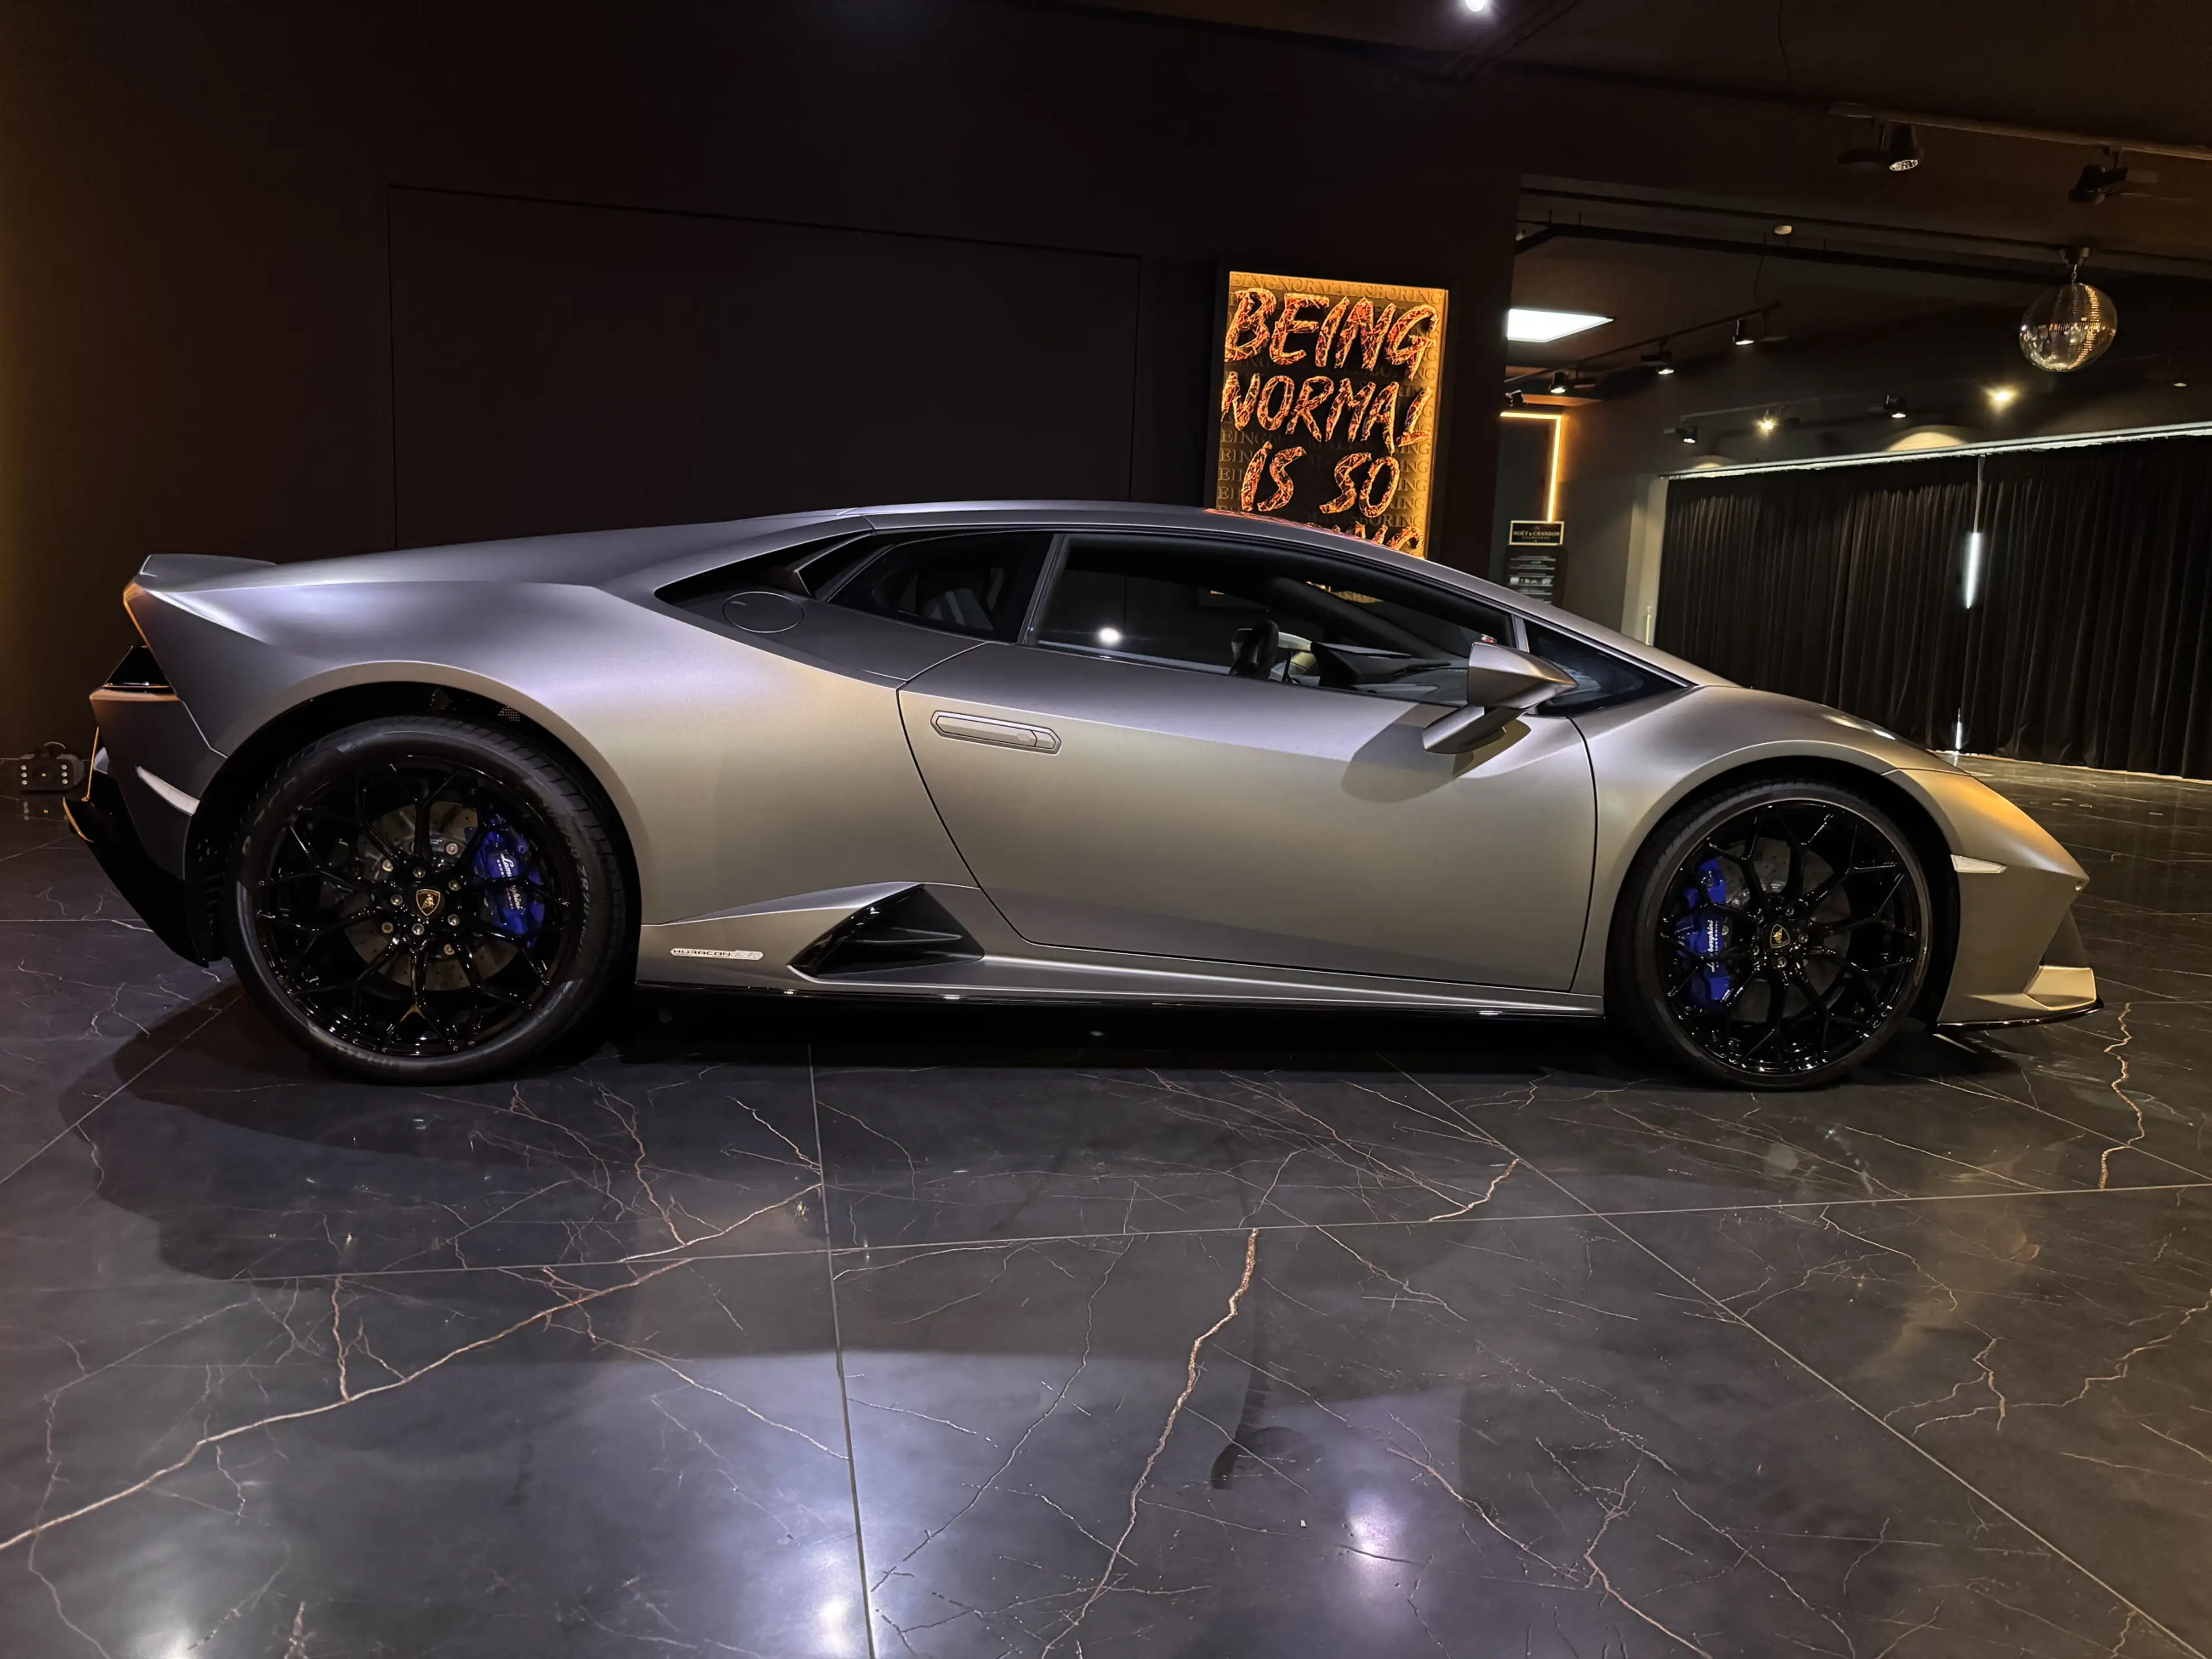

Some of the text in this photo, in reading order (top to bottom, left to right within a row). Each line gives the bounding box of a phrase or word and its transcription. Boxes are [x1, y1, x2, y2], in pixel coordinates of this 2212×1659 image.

[1224, 287, 1440, 381] BEING
[1220, 371, 1434, 456] NORMAL
[1241, 441, 1307, 512] IS
[1319, 452, 1400, 518] SO
